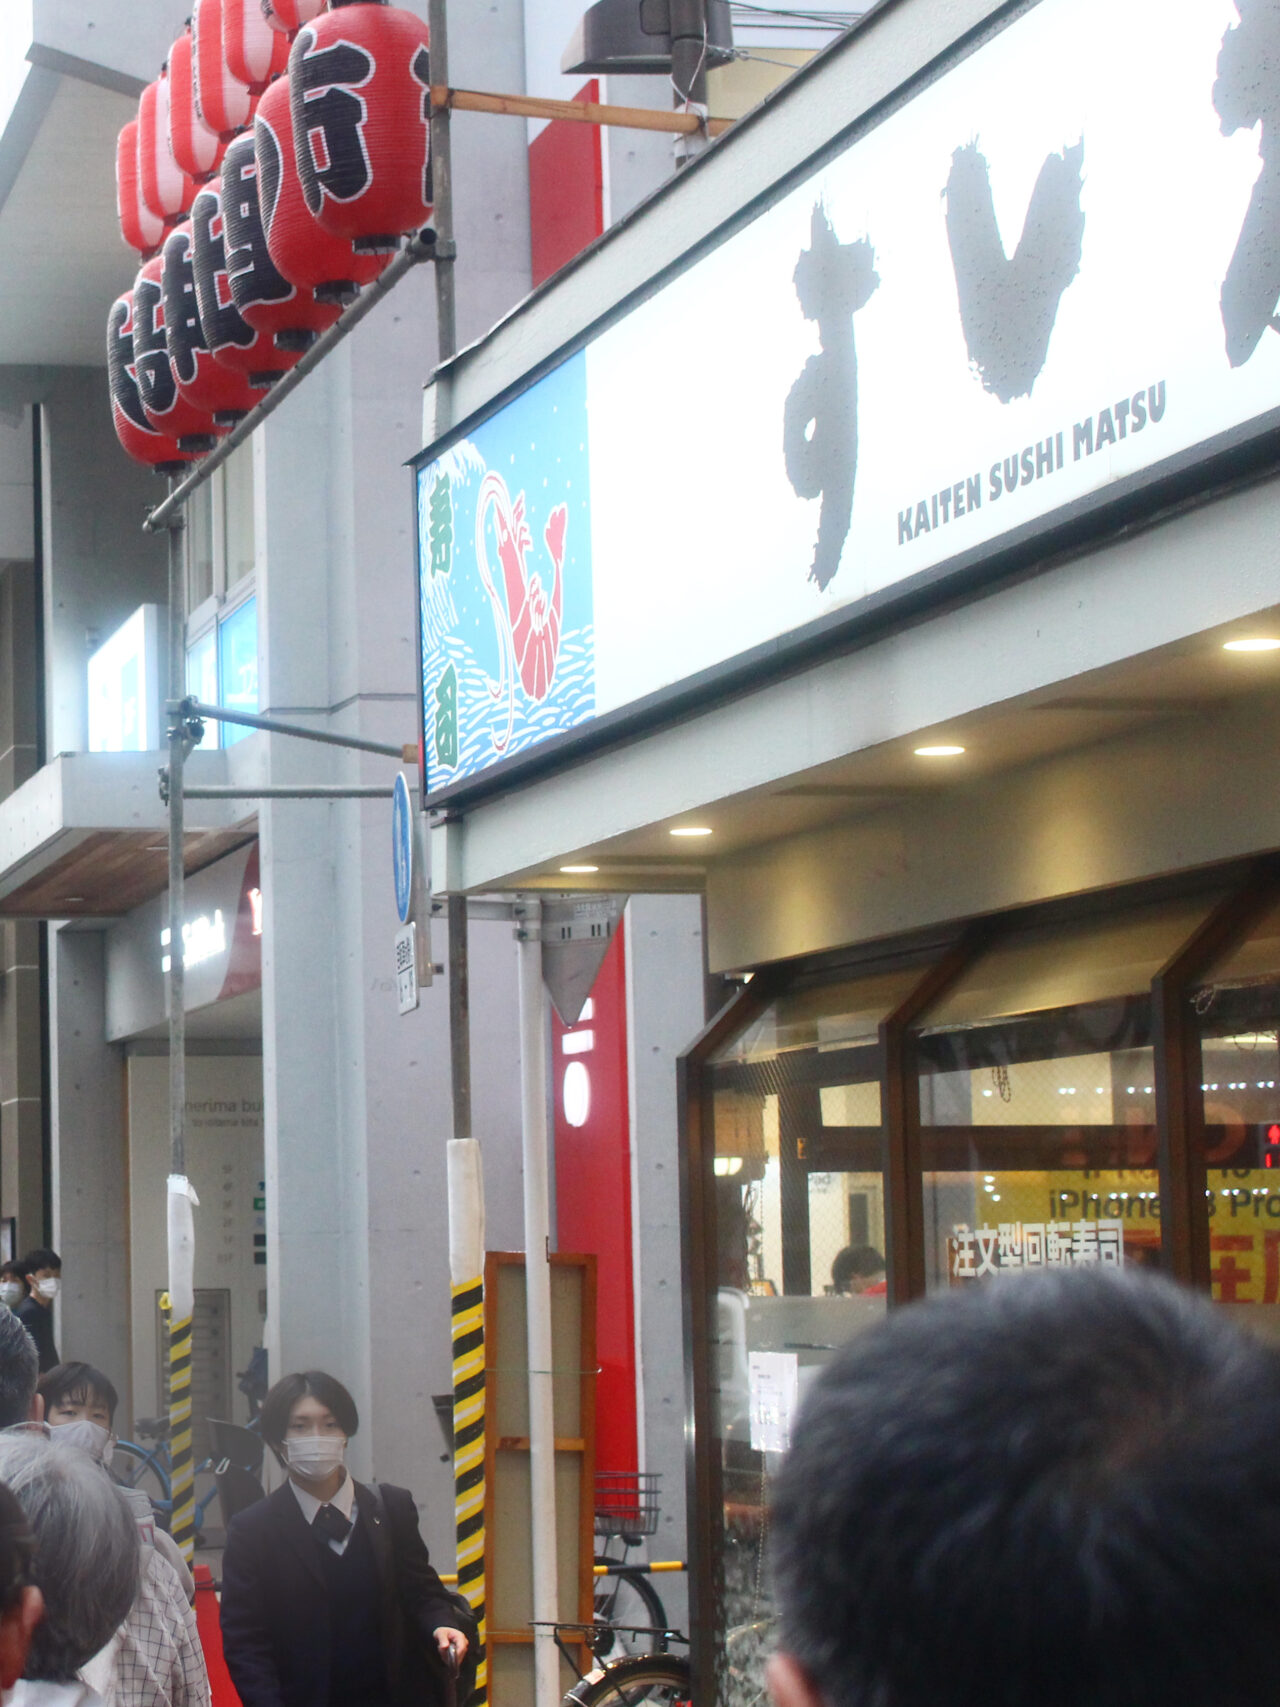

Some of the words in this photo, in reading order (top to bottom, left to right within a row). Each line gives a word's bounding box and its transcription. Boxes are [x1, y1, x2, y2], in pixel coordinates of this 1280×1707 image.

[897, 473, 982, 546] KAITEN
[988, 430, 1065, 502] SUSHI
[1072, 379, 1167, 462] MATSU
[1049, 1189, 1161, 1219] iPhone
[953, 1219, 1124, 1278] 注文型回転寿司
